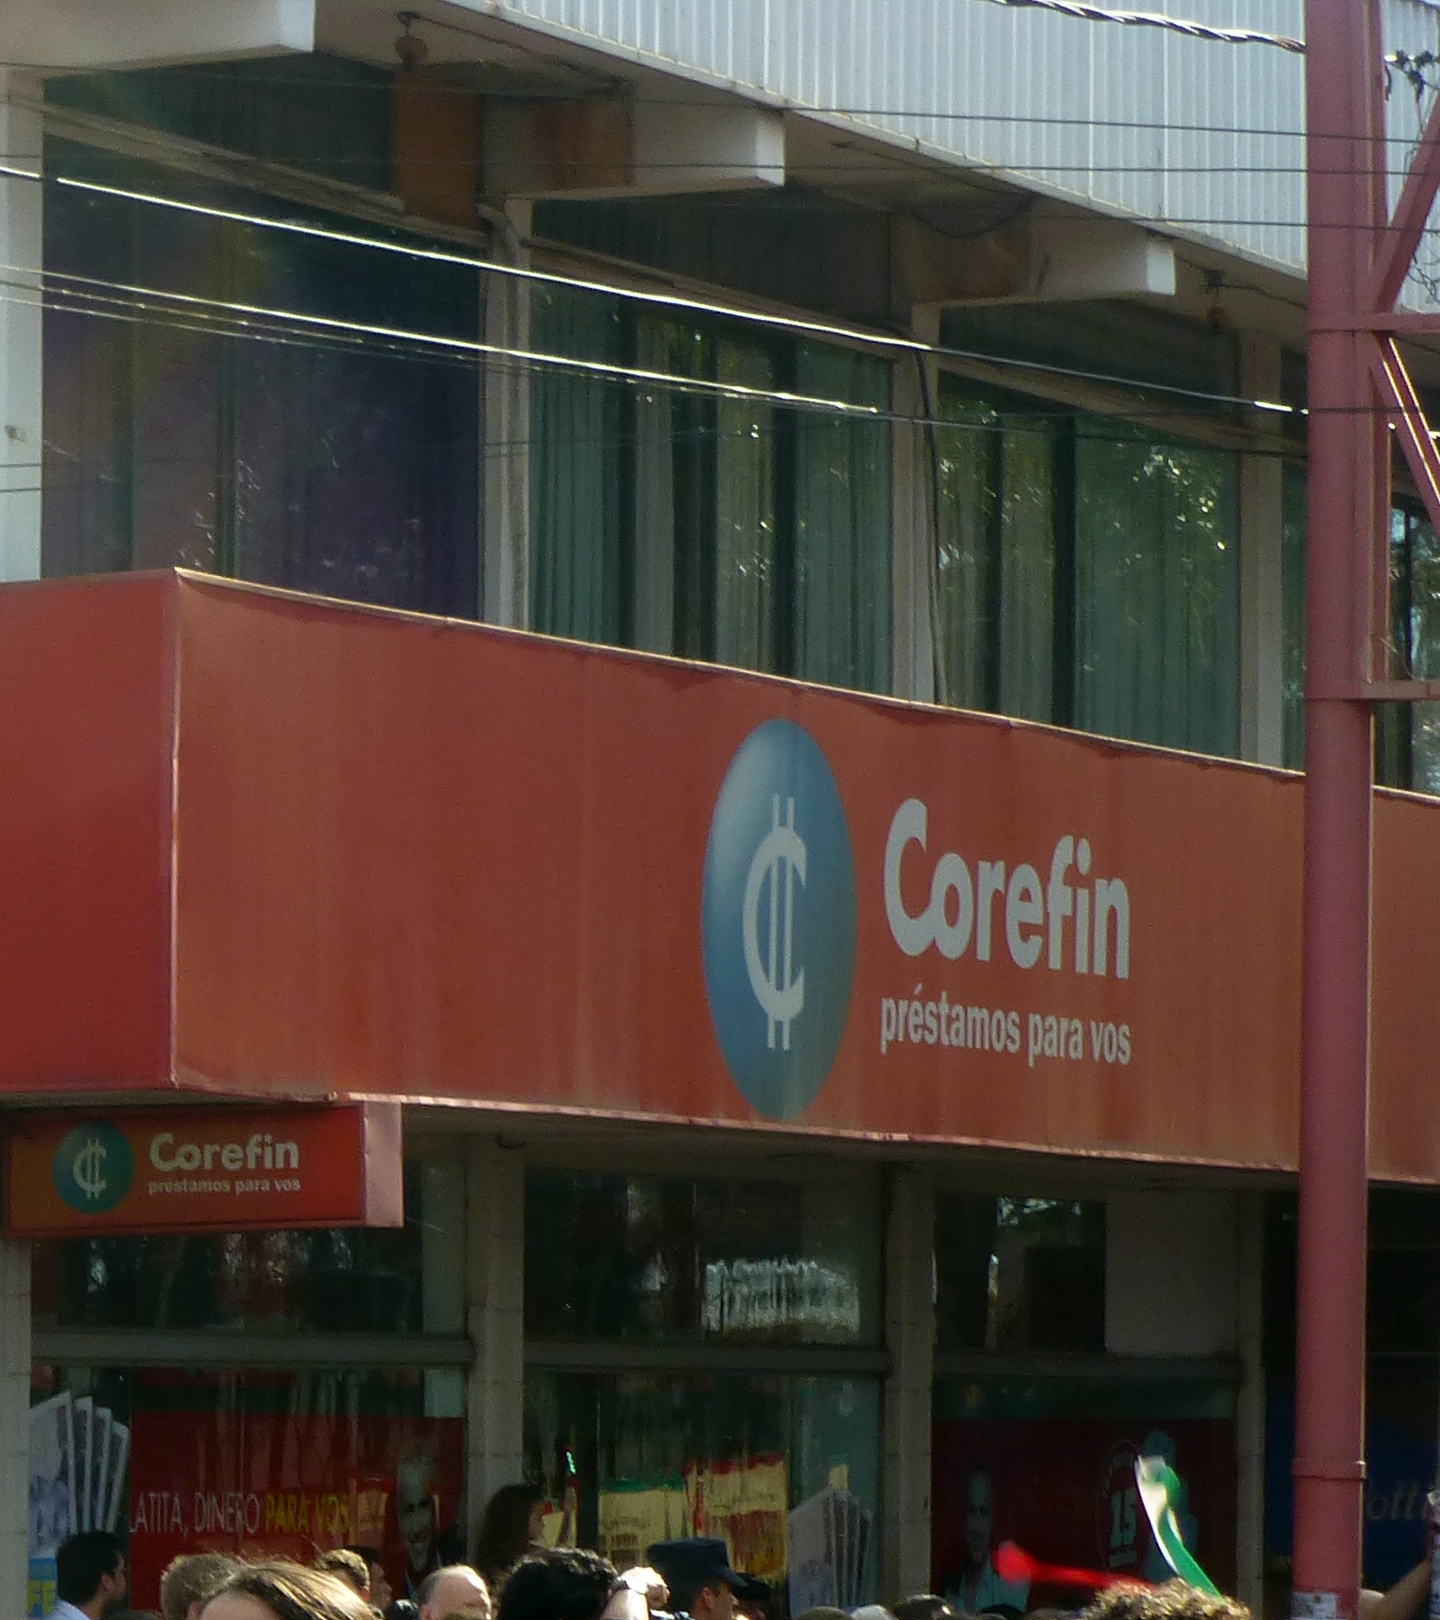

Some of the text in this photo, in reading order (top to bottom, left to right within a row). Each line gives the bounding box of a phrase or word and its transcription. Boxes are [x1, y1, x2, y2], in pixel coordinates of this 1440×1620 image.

[883, 797, 1131, 980] Corefin
[881, 982, 1132, 1068] préstamos para vos
[149, 1131, 300, 1173] Corefin
[235, 1178, 270, 1196] para
[274, 1177, 301, 1192] vos
[194, 1491, 260, 1535] DINERO
[265, 1493, 310, 1533] PARA
